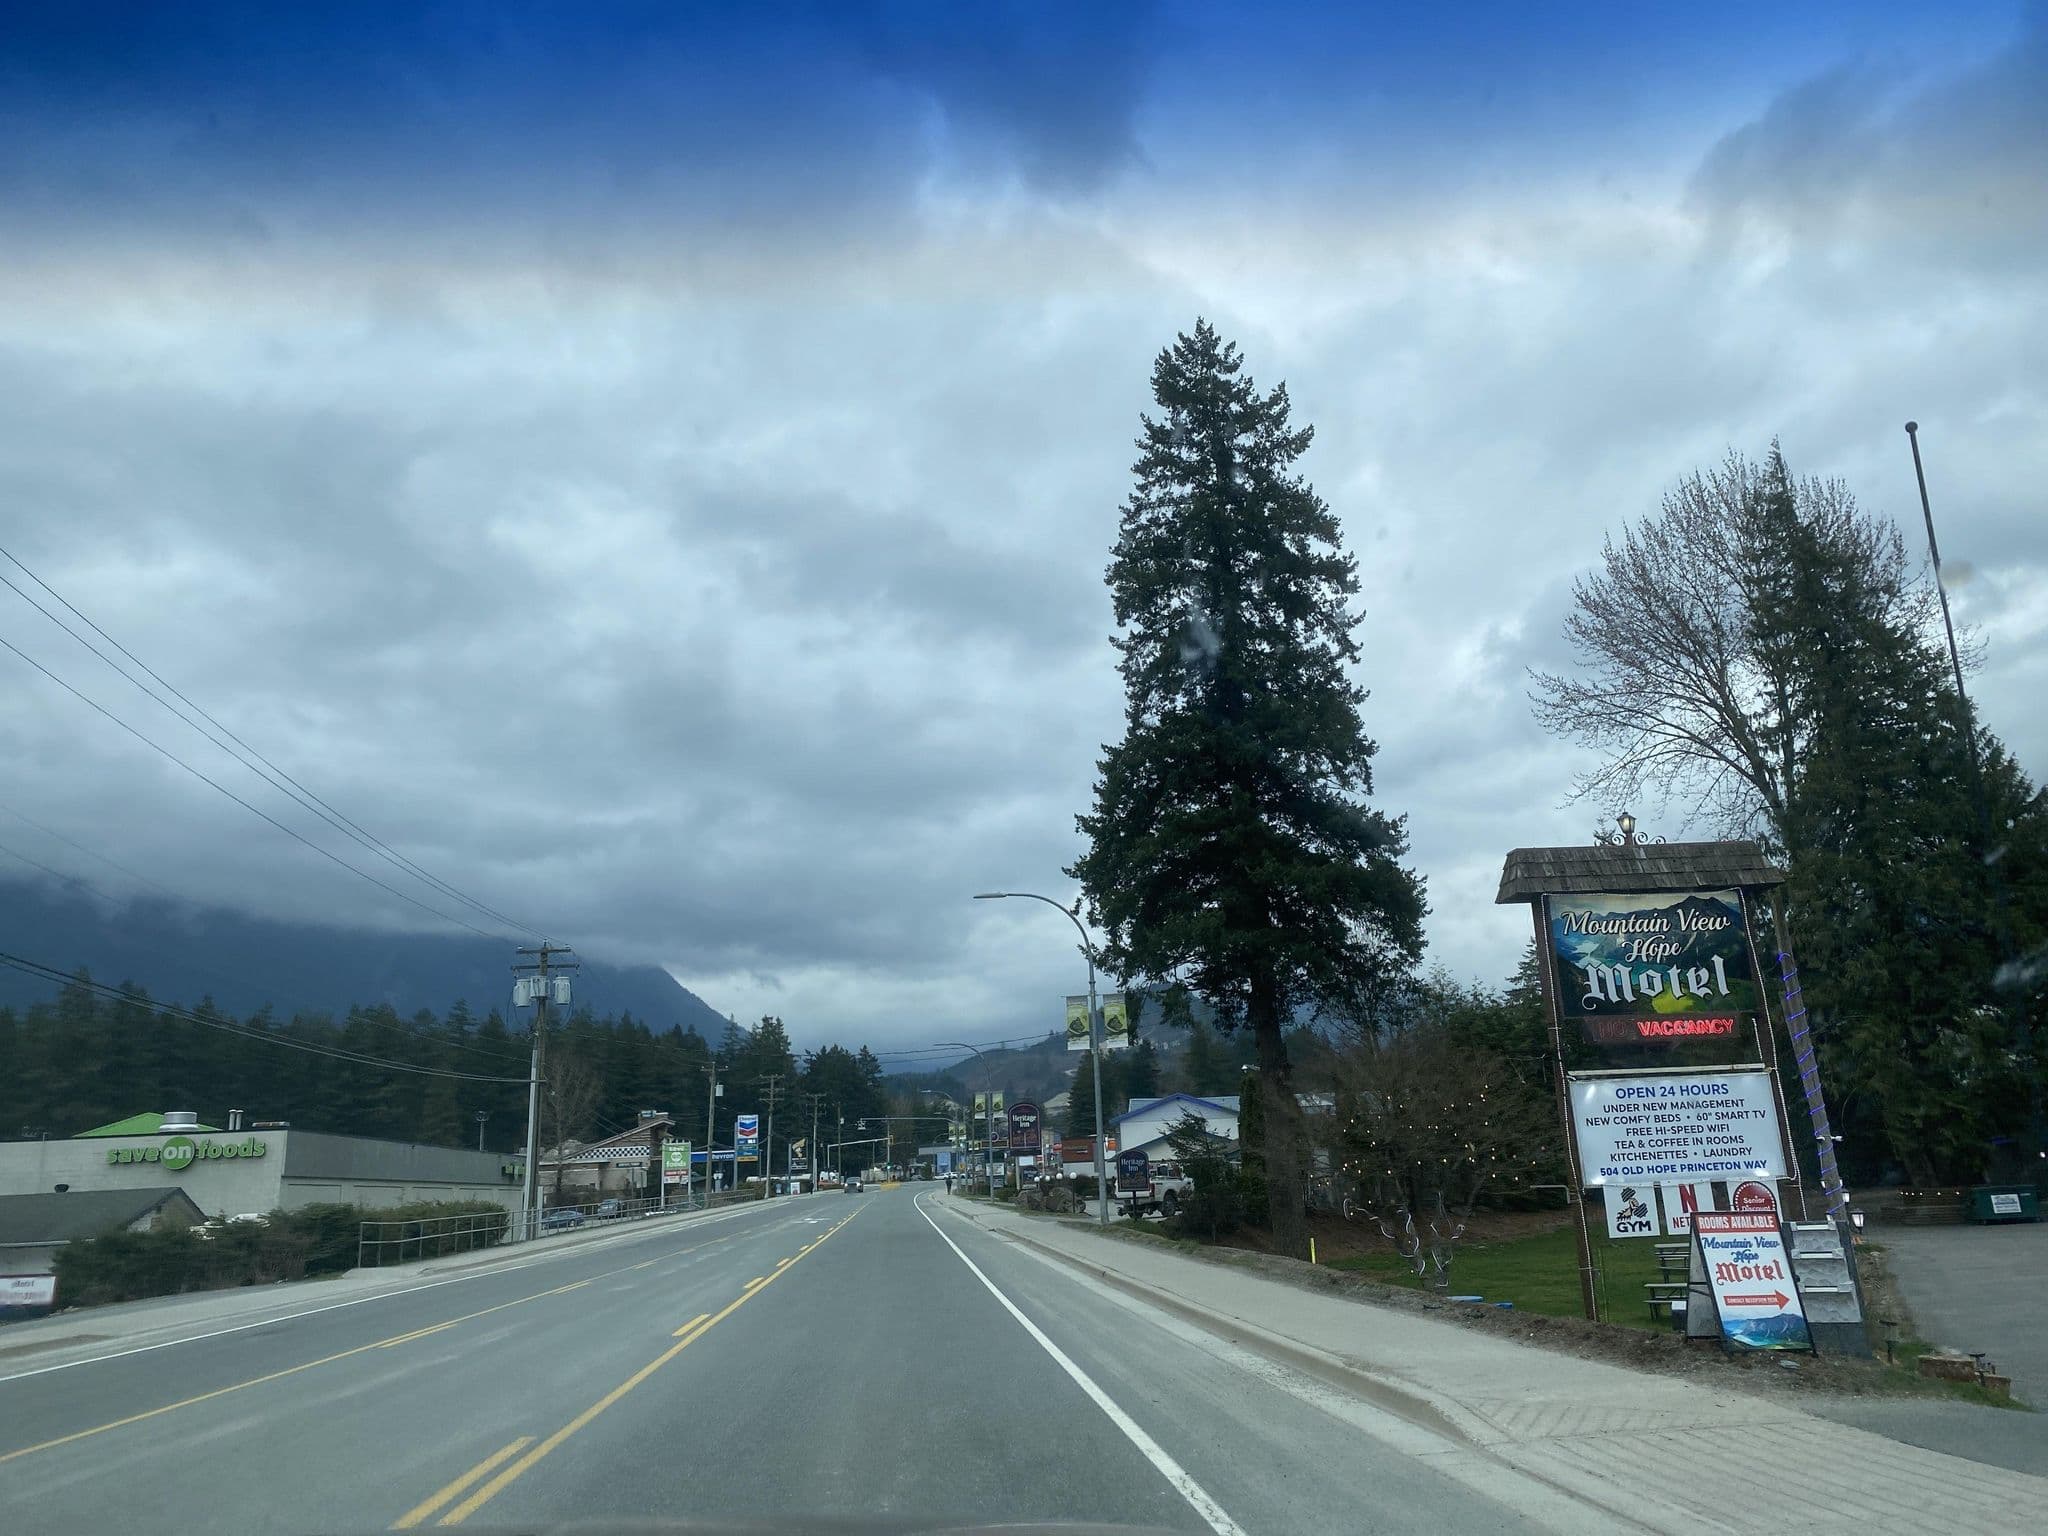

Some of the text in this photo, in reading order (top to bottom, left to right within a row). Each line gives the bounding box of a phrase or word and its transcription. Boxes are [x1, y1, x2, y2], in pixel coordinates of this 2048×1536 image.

[1562, 908, 1730, 935] Mountain View
[1622, 935, 1682, 963] Hope
[1582, 954, 1731, 1010] Motel
[1616, 1084, 1729, 1099] OPEN 24 HOURS
[1603, 1099, 1744, 1113] UNDER NEW MANAGEMENT
[1013, 1114, 1037, 1123] Heritage
[1586, 1117, 1610, 1126] NEW
[1613, 1115, 1650, 1125] COMFY
[1654, 1114, 1681, 1123] BEDS
[1715, 1111, 1749, 1120] SMART
[1752, 1110, 1766, 1119] TV
[1626, 1124, 1730, 1136] FREE HI-SPEED WIFI
[107, 1136, 265, 1163] save on foods
[1614, 1135, 1745, 1149] TEA & COFFEE IN ROOMS
[1121, 1158, 1145, 1166] Heritage
[1610, 1147, 1752, 1162] KITCHENETTES LAUNDRY
[1600, 1159, 1768, 1176] 504 OLD HOPE PRINCETON WAY
[1678, 1184, 1698, 1213] N
[1743, 1196, 1765, 1204] Senior
[1616, 1221, 1652, 1233] GYM
[1698, 1216, 1775, 1229] ROOMS AVAILABLE
[1702, 1236, 1780, 1249] Mountain View
[1731, 1249, 1759, 1264] Hope
[1716, 1259, 1785, 1285] Motel
